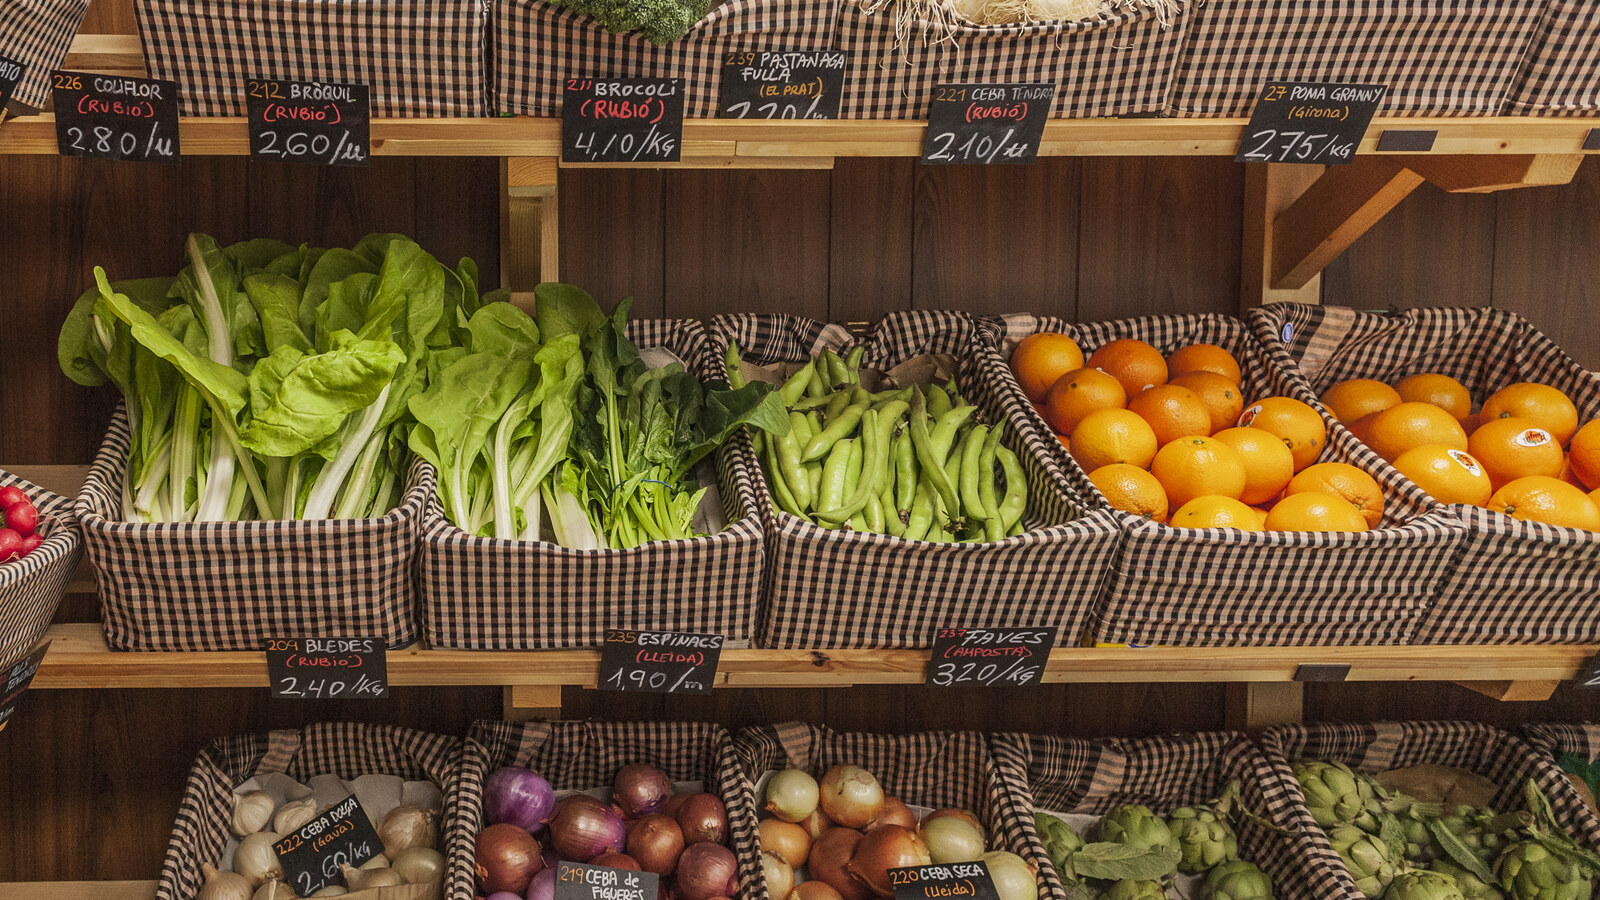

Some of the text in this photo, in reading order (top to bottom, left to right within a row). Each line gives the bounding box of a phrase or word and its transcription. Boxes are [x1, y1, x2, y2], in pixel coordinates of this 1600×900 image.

[725, 52, 845, 69] 239 PASTANAGA
[0, 61, 21, 81] ATO
[741, 67, 791, 83] FULLA
[54, 75, 162, 100] 226 COLIFLOR
[249, 81, 356, 102] 212 BRÒQUIL
[567, 80, 592, 91] 211
[759, 77, 823, 99] (EL PRAT)
[936, 86, 1054, 101] 221 CEBA TENDRA
[1264, 86, 1383, 103] 27 POMA GRANNY
[580, 97, 664, 124] (RUBIÓ)
[1288, 105, 1349, 121] (Girona)
[606, 631, 637, 644] 235
[939, 629, 1048, 646] 237 FAVES
[267, 639, 374, 654] 209 BLEDES
[944, 645, 1033, 658] (AMPOSTA)
[636, 649, 704, 667] (LLEIDA)
[276, 834, 304, 855] 222
[301, 816, 330, 839] CEBA
[560, 865, 640, 888] 219 CEBA de
[889, 863, 985, 885] 220 CEBA SECA
[591, 886, 645, 900] FIGUERES
